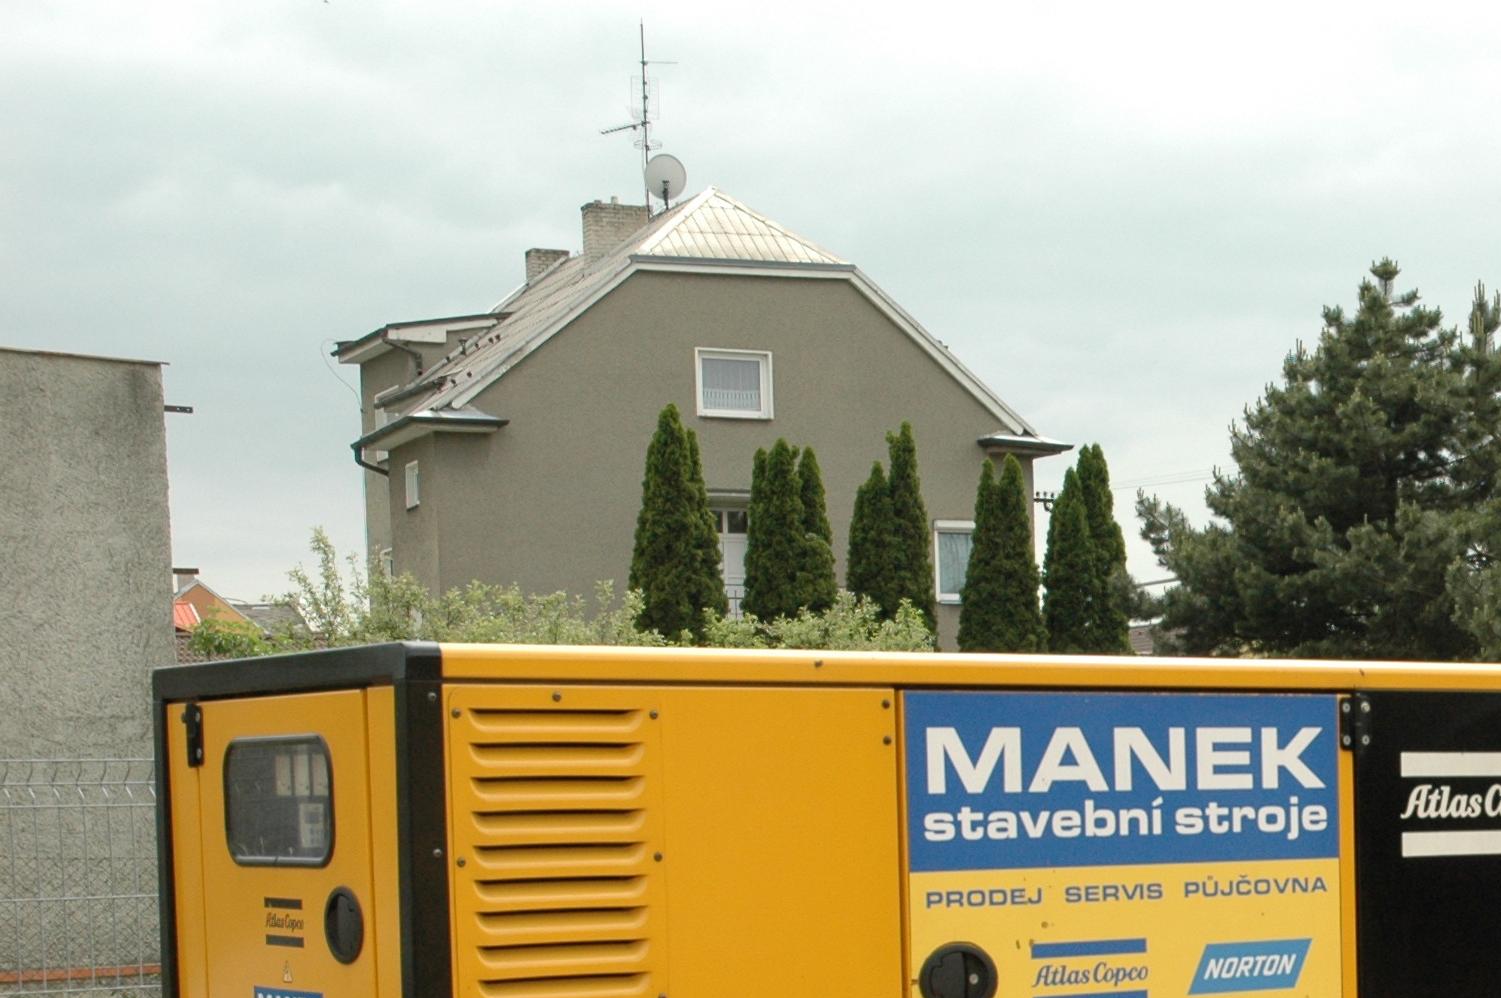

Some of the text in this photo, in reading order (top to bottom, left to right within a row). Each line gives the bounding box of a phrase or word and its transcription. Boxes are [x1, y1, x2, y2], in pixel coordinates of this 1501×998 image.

[926, 727, 1327, 794] MANEK
[924, 796, 1328, 842] stavební stroje
[1400, 784, 1482, 819] Atlas
[926, 874, 1328, 909] PRODEJ SERVIS PŮJČOVNA
[1032, 962, 1148, 988] Atlas Copco
[1203, 953, 1297, 980] NORTON
